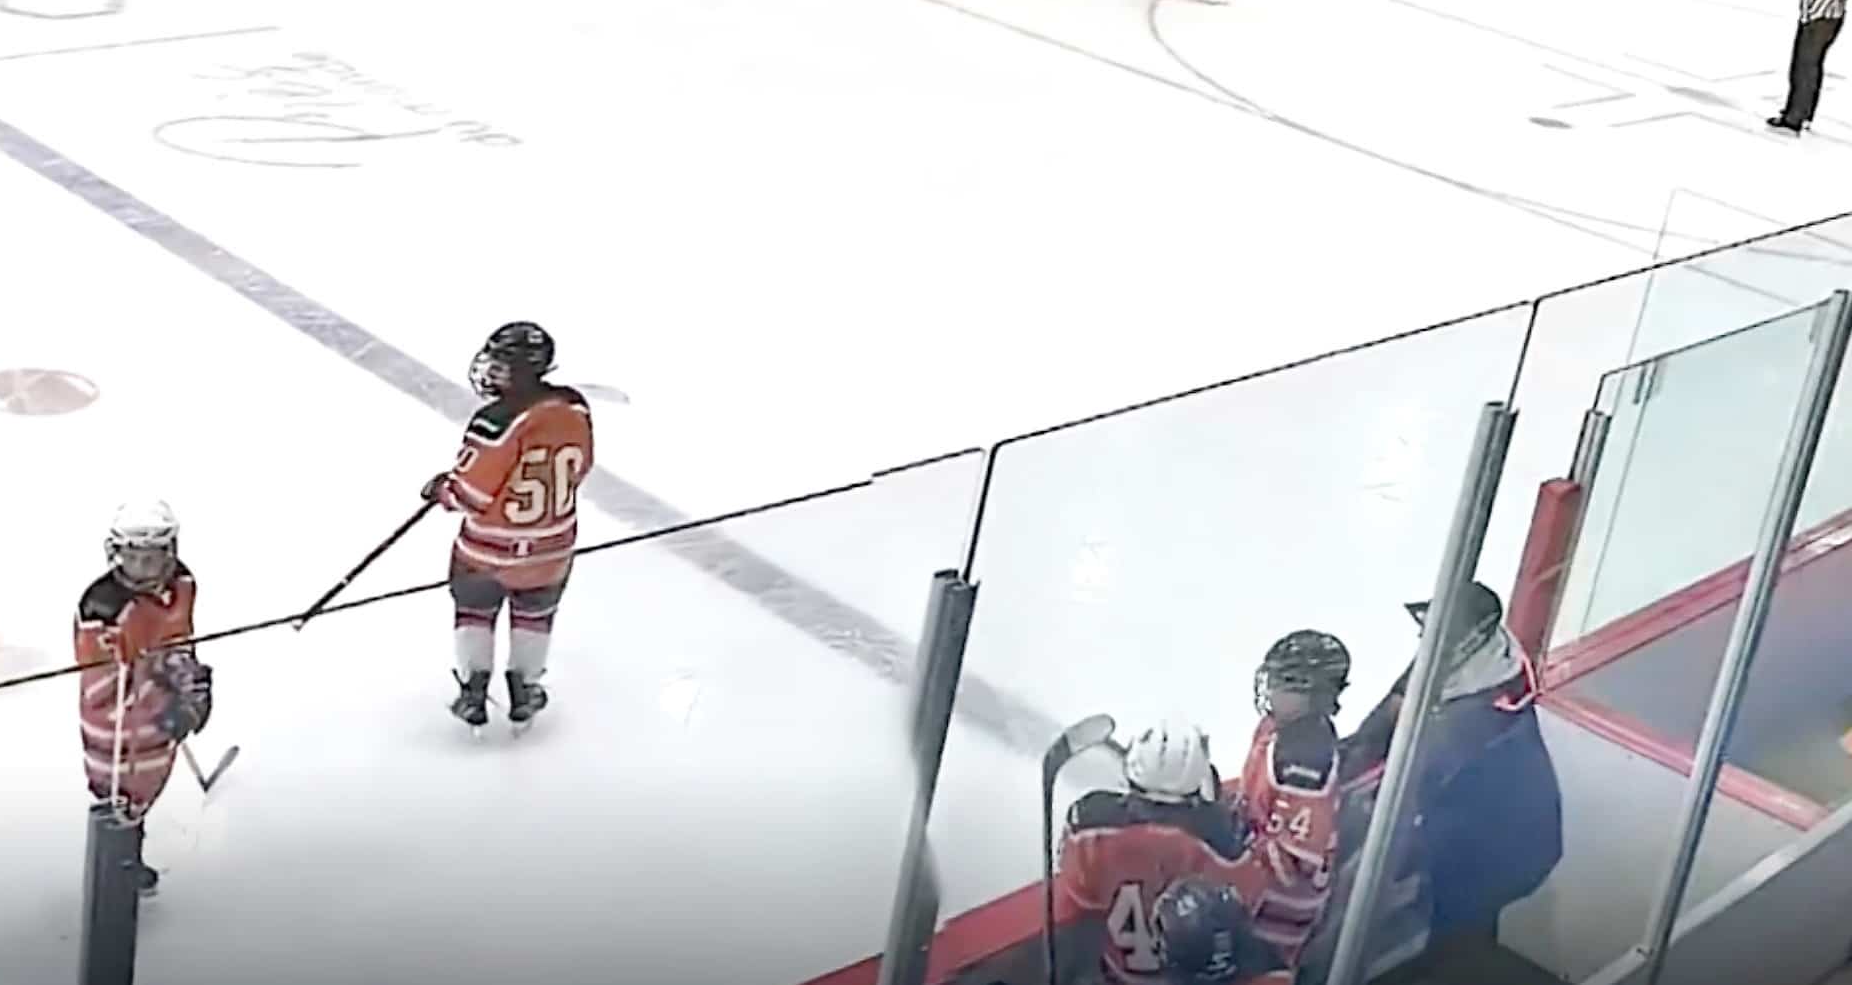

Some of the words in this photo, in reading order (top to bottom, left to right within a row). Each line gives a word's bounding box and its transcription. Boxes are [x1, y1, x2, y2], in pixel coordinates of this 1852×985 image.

[503, 445, 584, 525] 50
[1266, 799, 1313, 843] 54
[1106, 882, 1166, 973] 4
